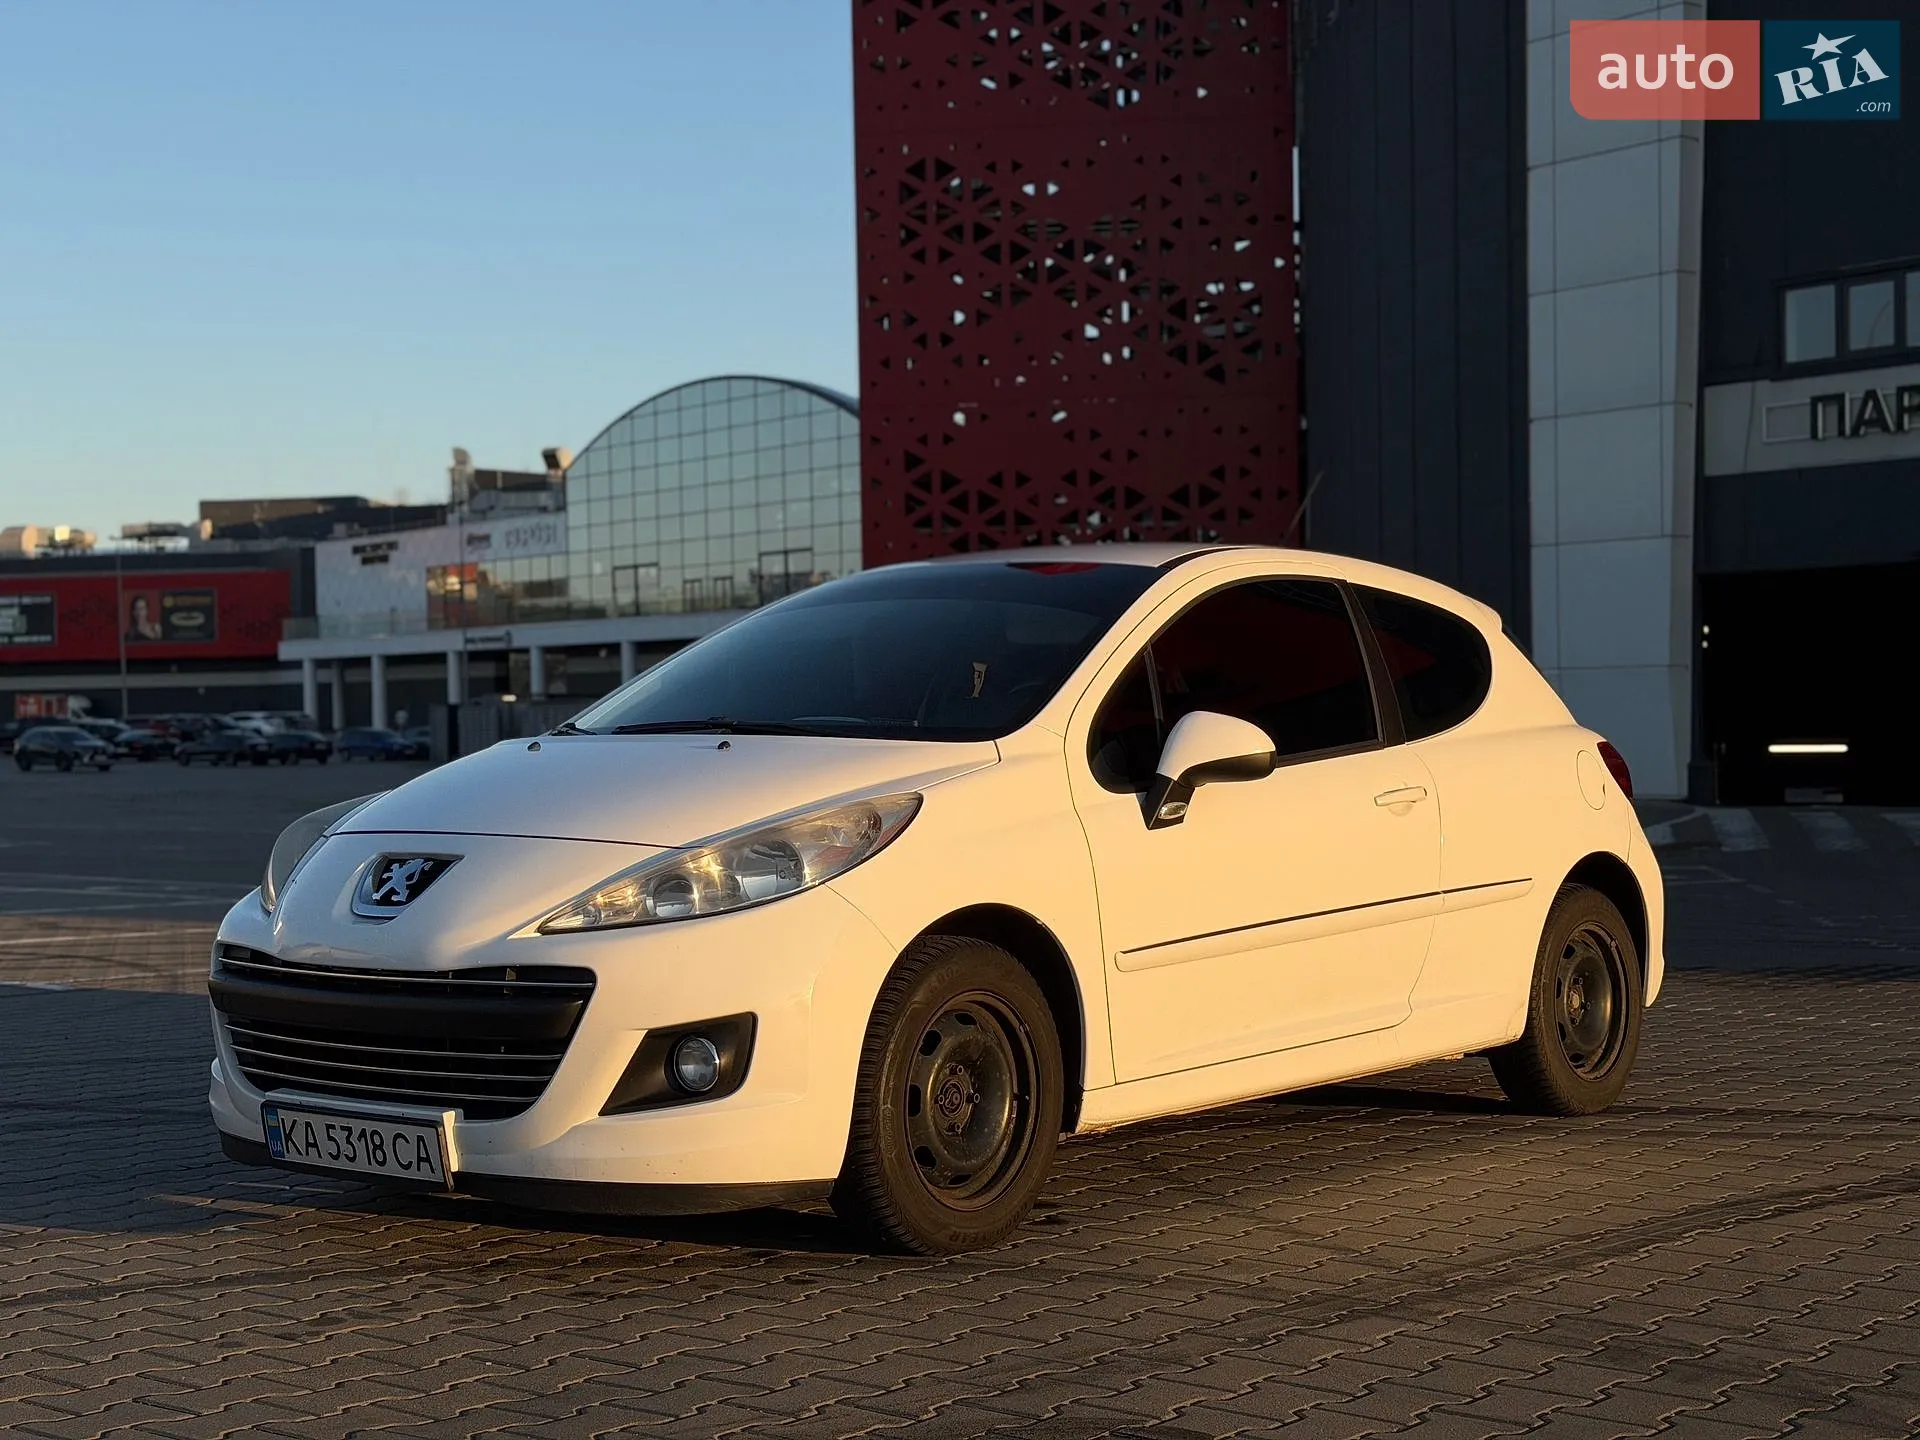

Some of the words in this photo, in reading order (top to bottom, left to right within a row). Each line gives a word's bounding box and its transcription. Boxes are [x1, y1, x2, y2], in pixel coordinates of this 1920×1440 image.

[271, 1140, 283, 1152] UA
[280, 1117, 322, 1159] KA
[324, 1123, 387, 1167] 5318
[392, 1131, 436, 1174] CA
